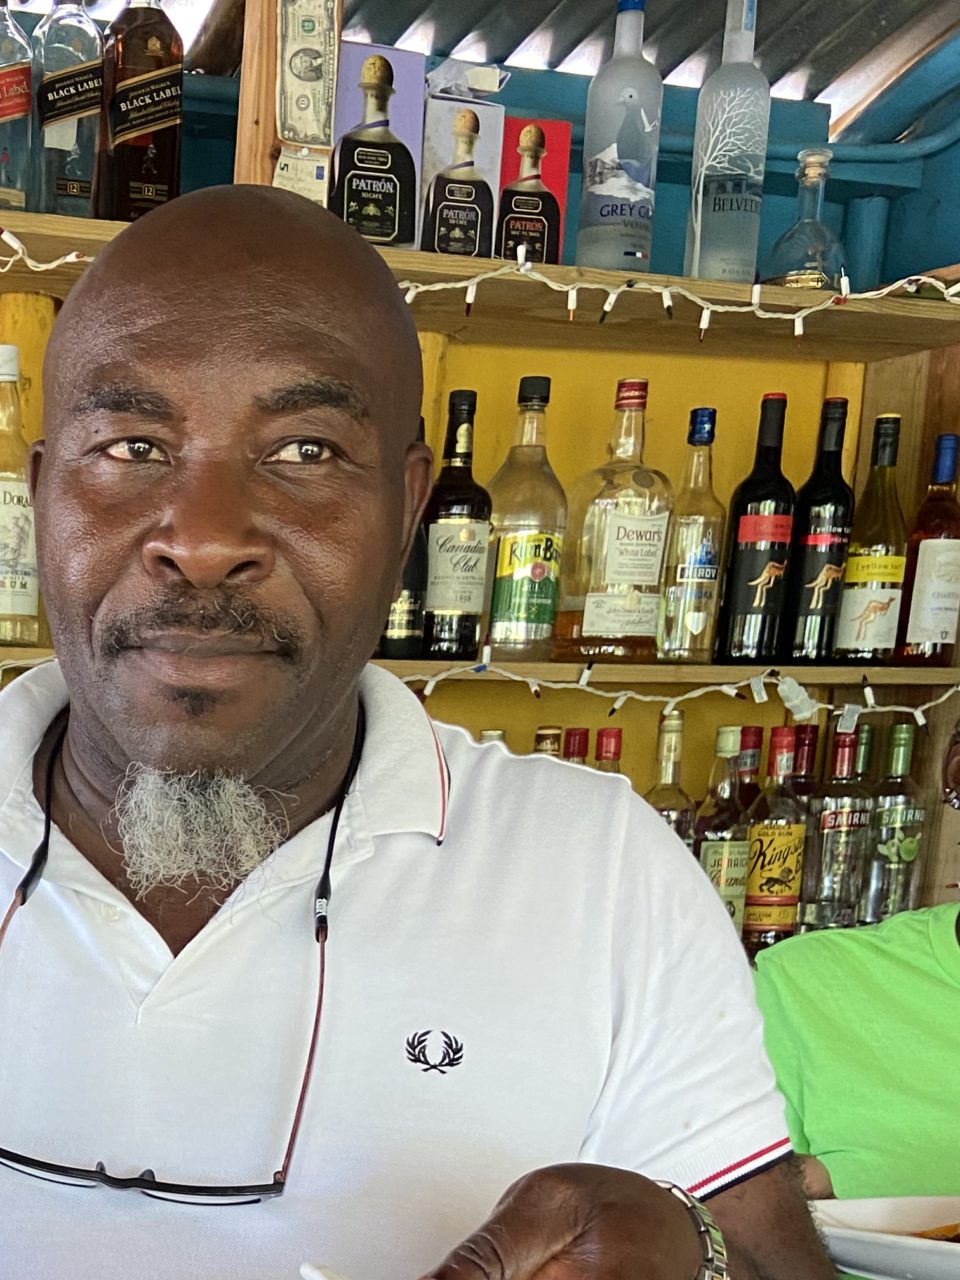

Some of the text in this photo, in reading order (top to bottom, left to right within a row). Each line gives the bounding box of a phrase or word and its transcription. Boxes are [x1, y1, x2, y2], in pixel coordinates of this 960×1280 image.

[3, 80, 30, 98] Label
[47, 86, 77, 101] BLACK
[119, 95, 152, 112] BLACK
[69, 183, 78, 192] 12
[144, 186, 153, 196] 12
[352, 178, 394, 193] PATRÓN
[600, 203, 634, 218] GREY
[616, 526, 663, 542] Dewar's
[450, 554, 481, 572] Club
[860, 563, 886, 572] yellow
[0, 581, 28, 590] RUM
